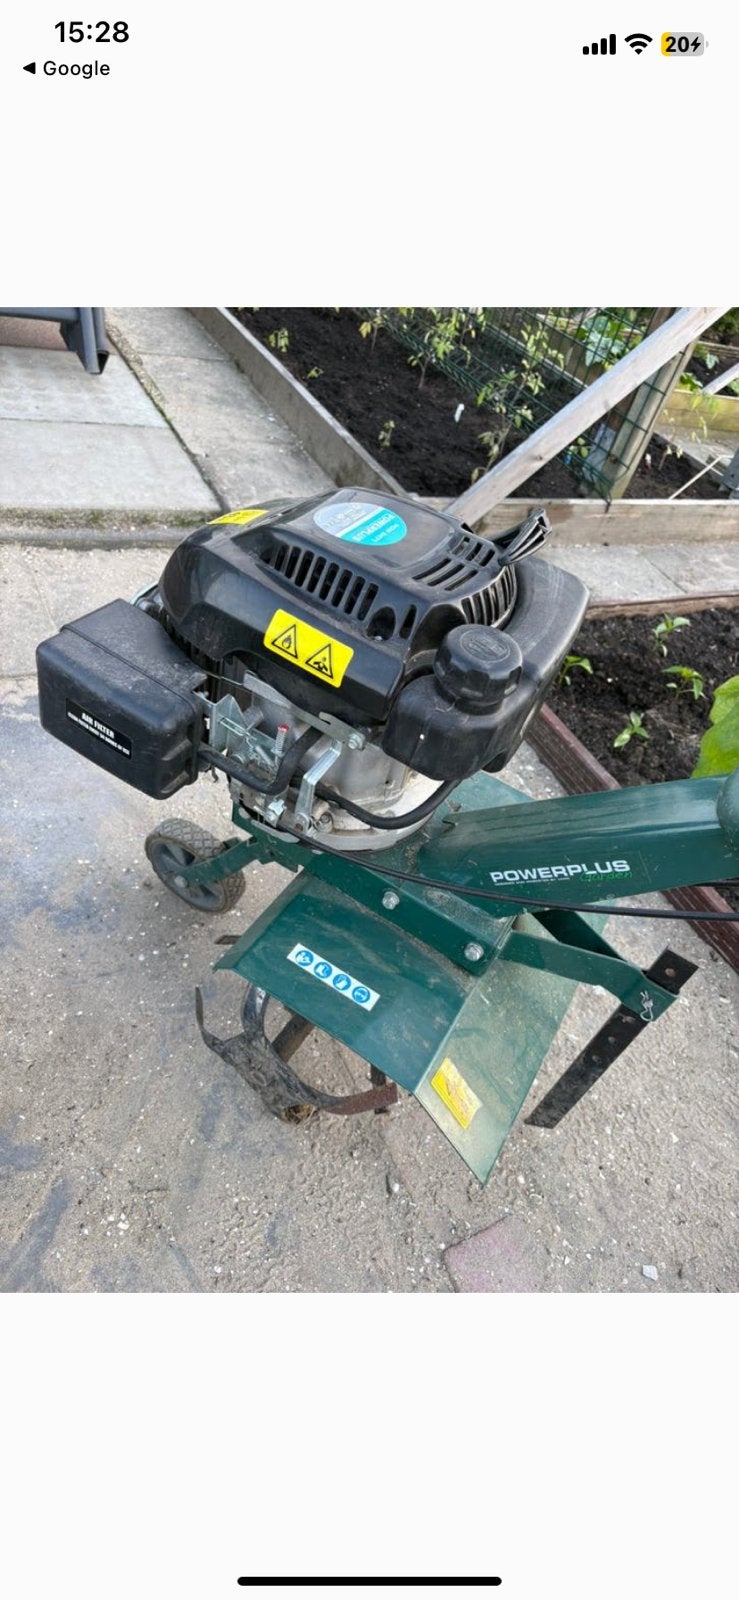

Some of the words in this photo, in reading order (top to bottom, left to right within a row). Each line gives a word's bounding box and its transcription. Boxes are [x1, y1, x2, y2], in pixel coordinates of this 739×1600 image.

[81, 712, 94, 726] AIR
[94, 720, 115, 739] FILTER
[489, 859, 631, 883] POWERPLUS
[580, 870, 633, 883] Garden
